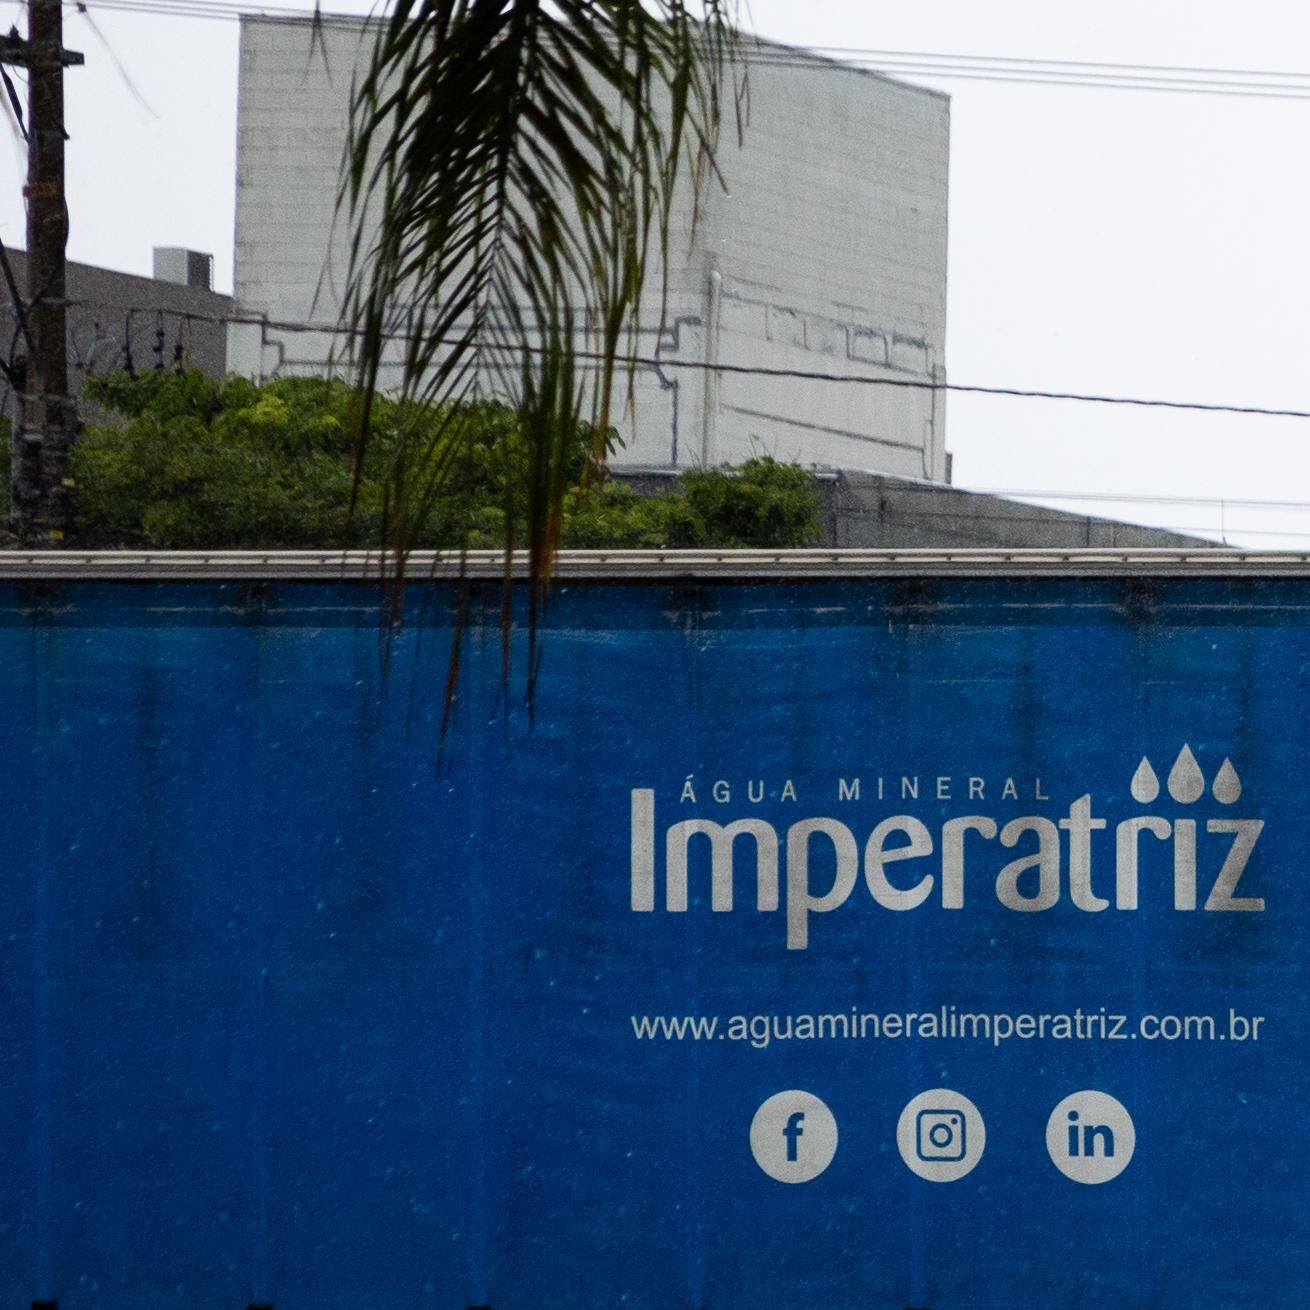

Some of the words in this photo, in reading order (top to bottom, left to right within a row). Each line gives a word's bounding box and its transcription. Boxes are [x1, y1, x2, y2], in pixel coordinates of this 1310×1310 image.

[681, 773, 797, 803] ÁGUA
[838, 776, 1049, 802] MINERAL
[630, 788, 1266, 950] Imperatriz
[631, 1006, 1265, 1049] www.aguamineralimperatriz.com.br
